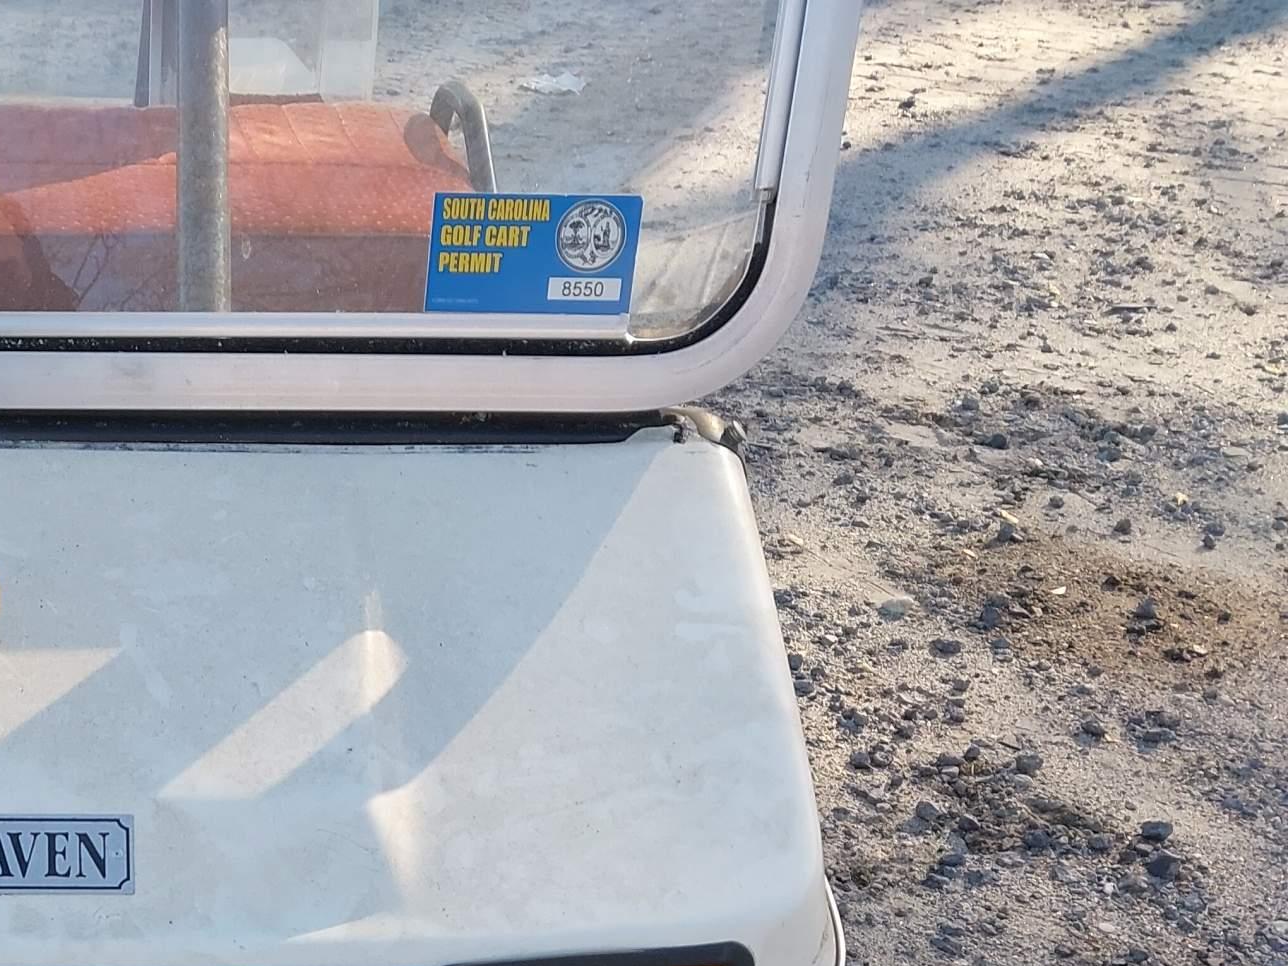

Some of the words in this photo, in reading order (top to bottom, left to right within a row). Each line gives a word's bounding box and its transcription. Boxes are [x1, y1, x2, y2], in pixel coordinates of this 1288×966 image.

[442, 198, 486, 221] SOUTH
[487, 199, 550, 222] CAROLINA
[439, 225, 481, 247] GOLF
[484, 226, 531, 248] CART
[437, 252, 503, 273] PERMIT
[561, 281, 605, 298] 8550
